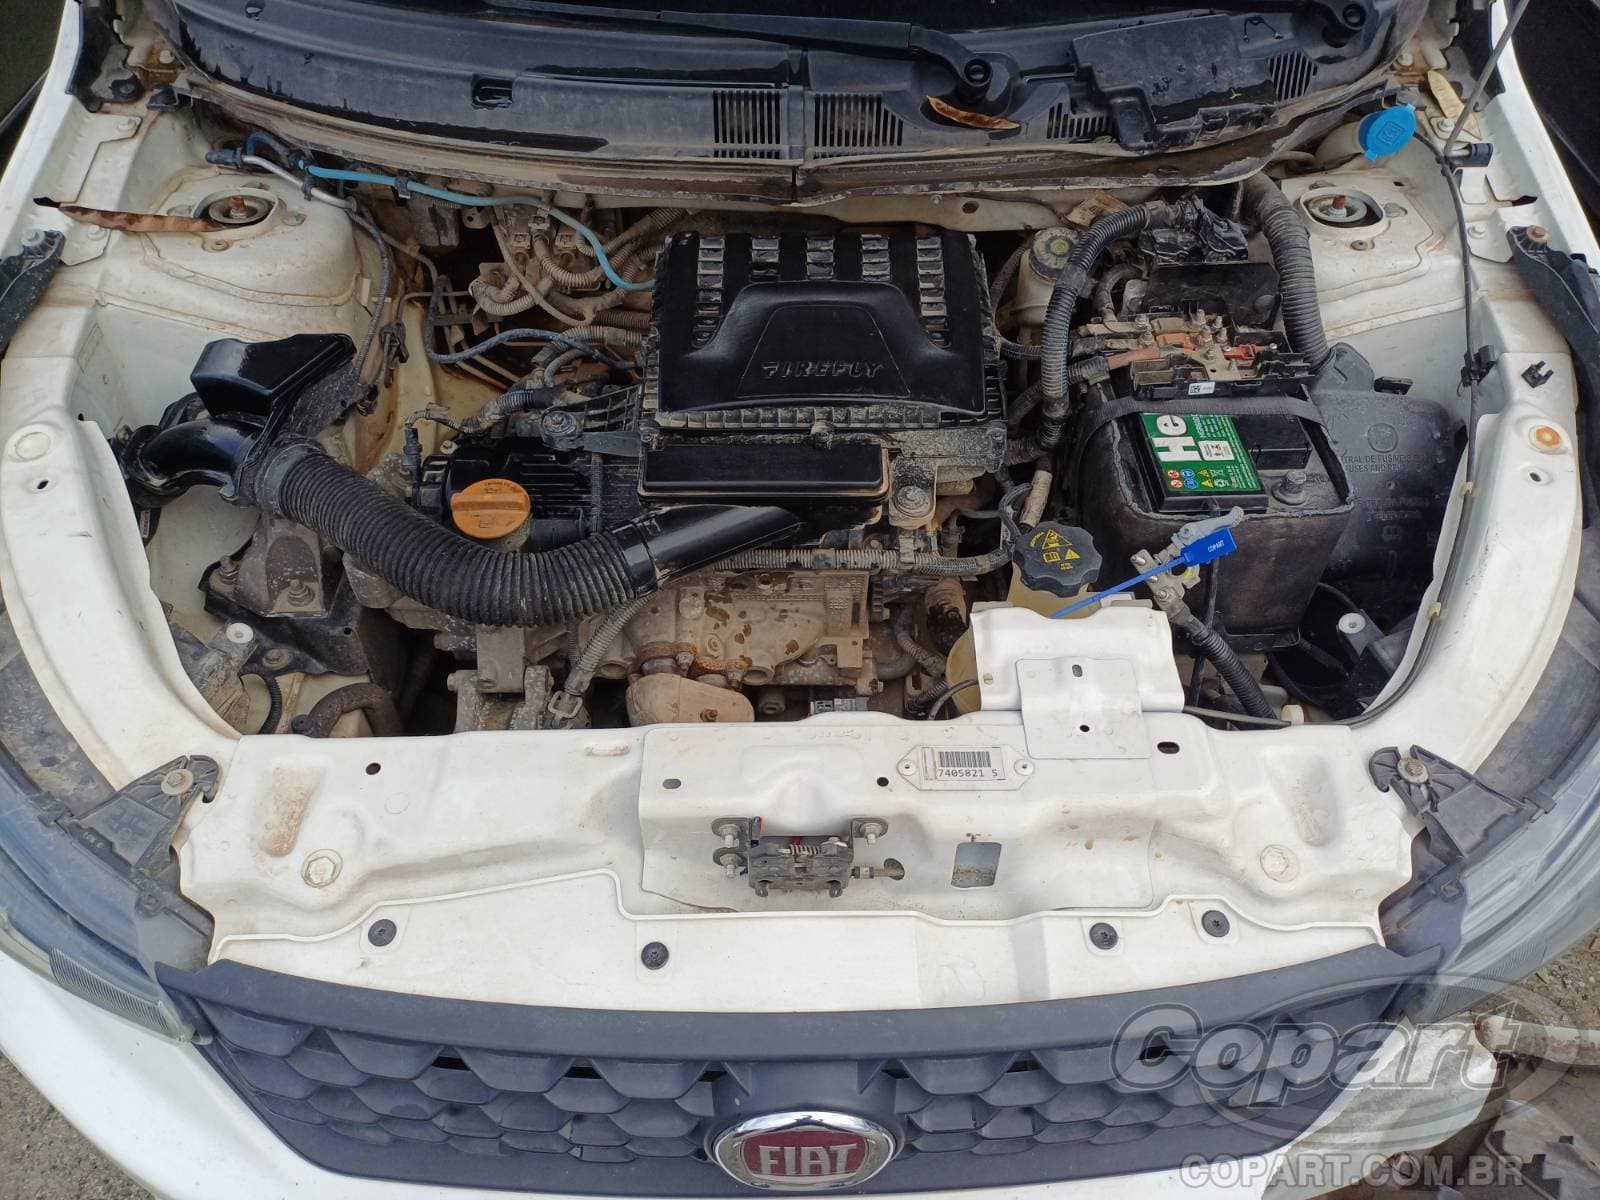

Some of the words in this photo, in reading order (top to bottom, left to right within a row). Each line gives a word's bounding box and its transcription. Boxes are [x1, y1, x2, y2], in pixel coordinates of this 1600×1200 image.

[762, 361, 884, 378] FIREFLY
[938, 768, 985, 778] 7405821
[758, 1143, 857, 1177] FIAT
